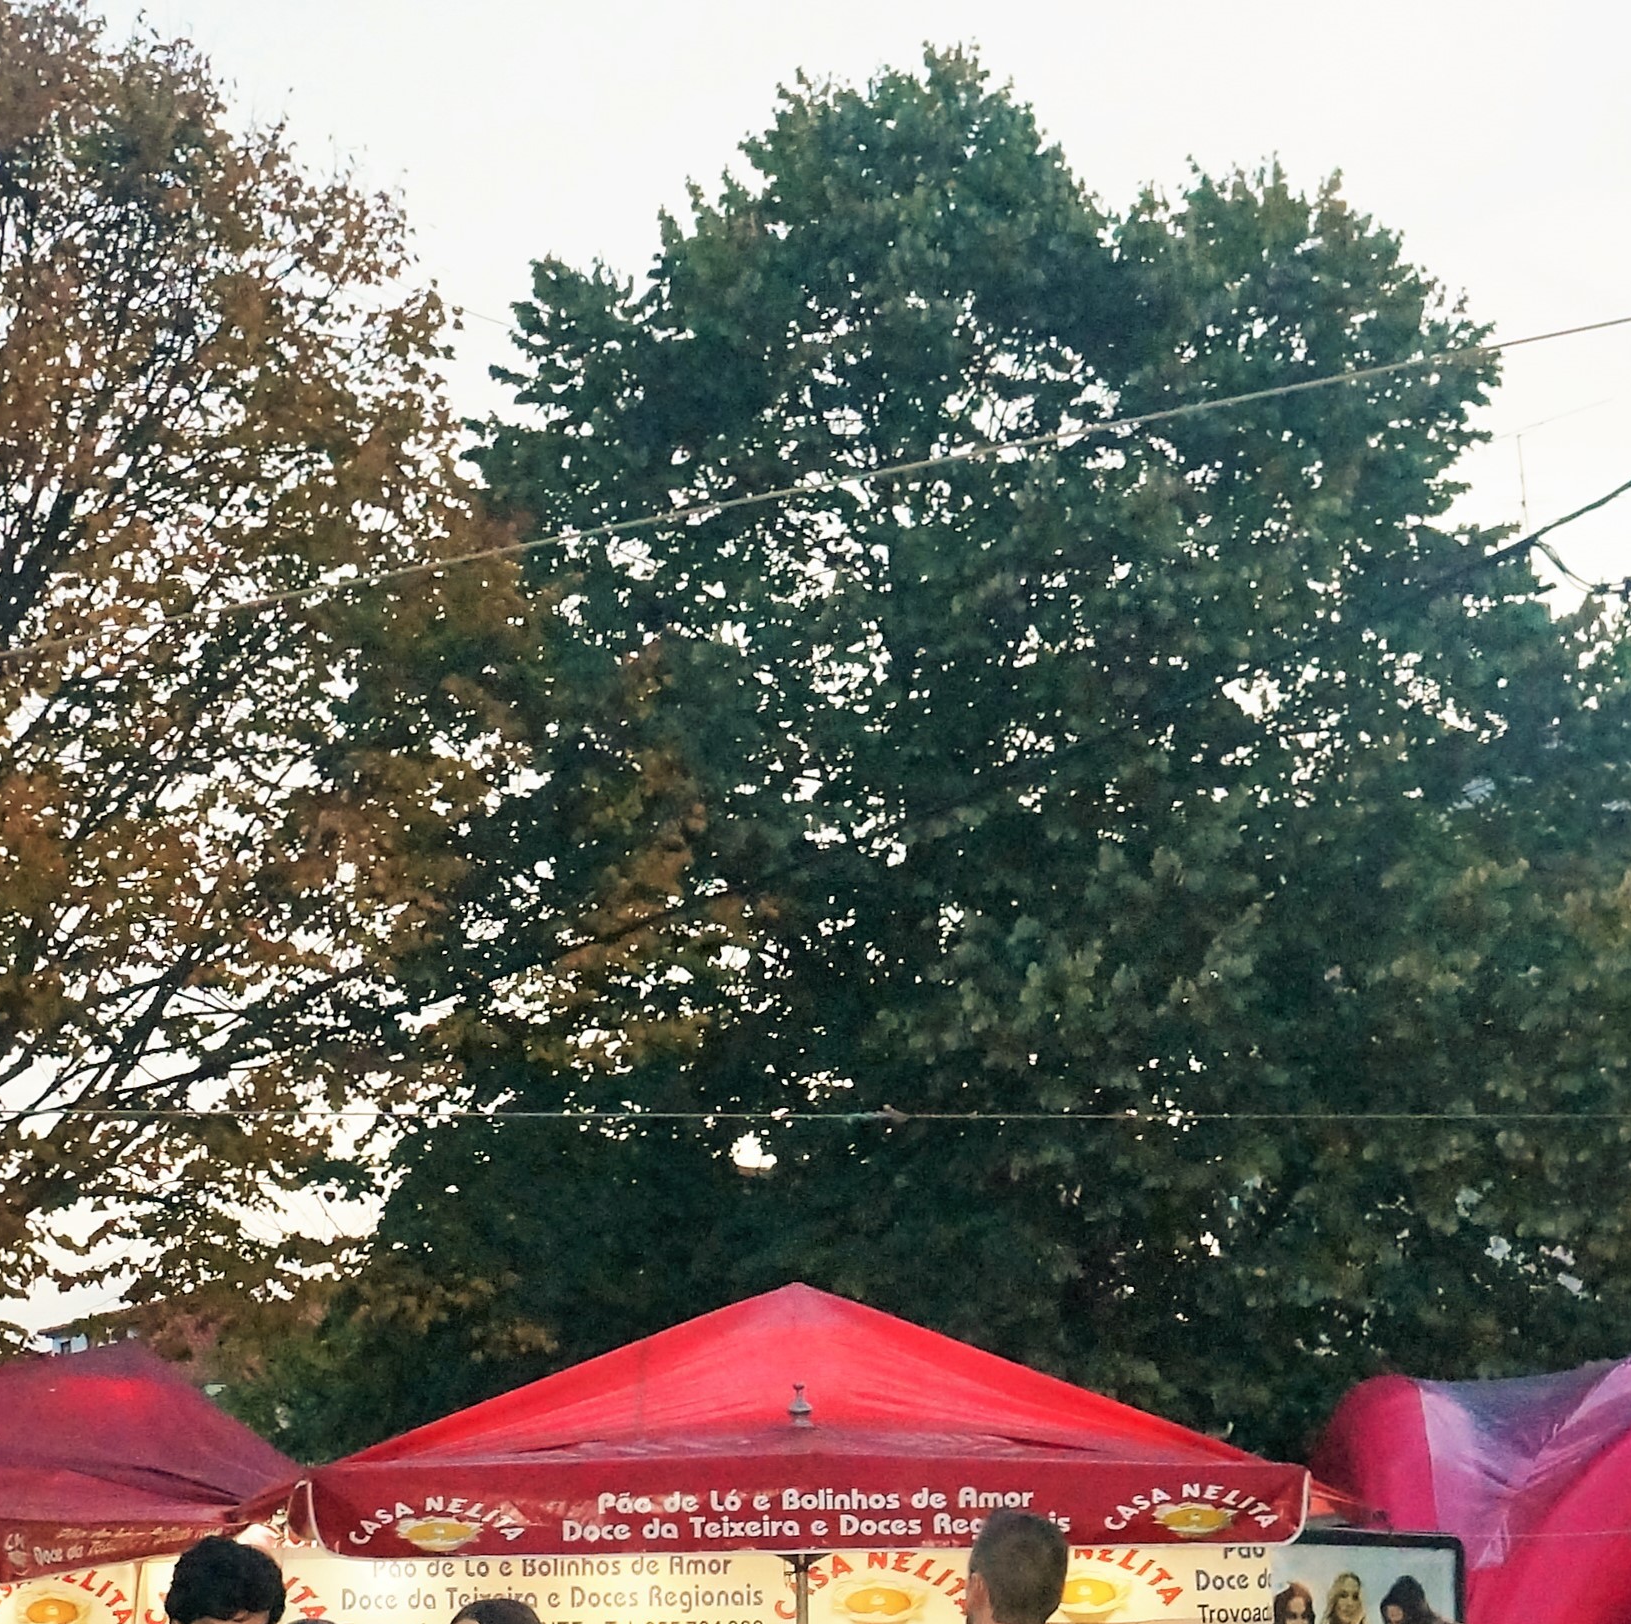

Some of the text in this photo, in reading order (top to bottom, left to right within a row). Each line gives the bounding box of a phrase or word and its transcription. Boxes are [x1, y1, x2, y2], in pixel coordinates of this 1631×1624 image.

[597, 1487, 1034, 1514] Pão de Ló e Bolinhos de Amor
[1103, 1483, 1279, 1531] CASA NELITA
[348, 1495, 525, 1545] CASA NELITA
[562, 1511, 1071, 1542] Doce da Teixeira e Doces Regis
[499, 1561, 513, 1578] e
[521, 1558, 621, 1578] Bolinhos
[631, 1556, 660, 1576] de
[669, 1556, 733, 1576] Amor
[1195, 1569, 1249, 1591] Doce
[341, 1587, 398, 1611] Doce
[407, 1585, 438, 1610] da
[547, 1592, 561, 1608] e
[570, 1585, 640, 1609] Doces
[649, 1582, 764, 1613] Regionais
